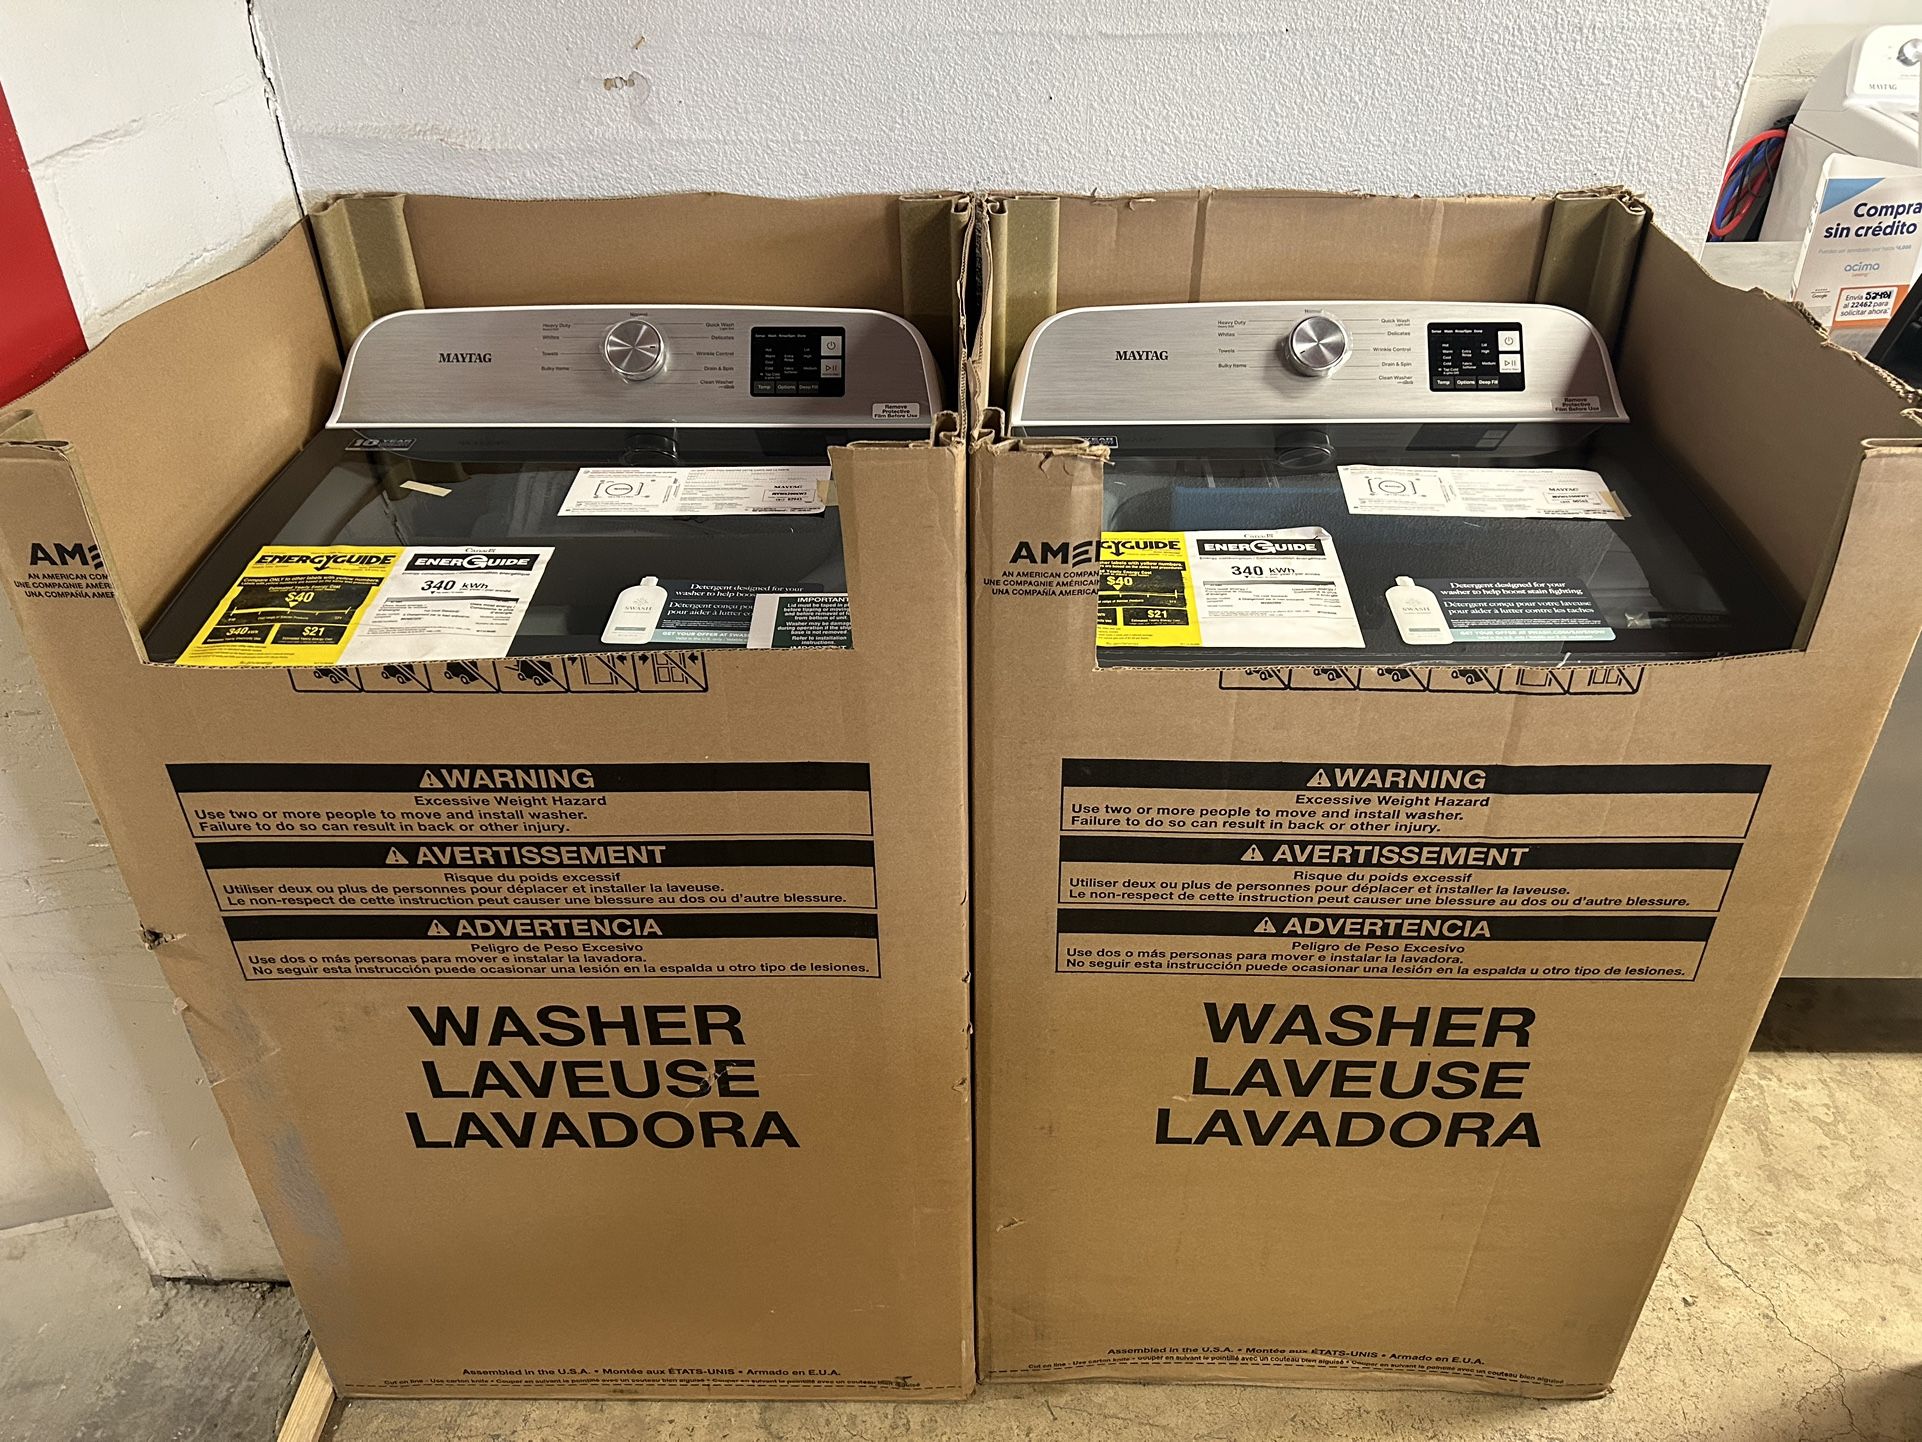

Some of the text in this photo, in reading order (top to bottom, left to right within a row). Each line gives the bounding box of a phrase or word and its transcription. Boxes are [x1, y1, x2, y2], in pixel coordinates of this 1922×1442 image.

[1853, 202, 1922, 219] Compra
[1824, 220, 1917, 238] sin crédito
[1844, 262, 1880, 272] acima
[1840, 309, 1867, 317] solicitar
[438, 352, 492, 363] MAYTAG
[1115, 350, 1169, 361] MAYTAG
[1204, 540, 1318, 554] ENERGUIDE
[255, 555, 396, 570] ENERGYGUIDE
[414, 554, 531, 569] ENERGUIDE
[1016, 571, 1061, 579] AMERICAN
[1231, 566, 1264, 576] 340
[14, 580, 31, 588] UNE
[32, 581, 84, 589] COMPAGNIE
[421, 580, 489, 591] 340 kWh
[983, 578, 1001, 586] UNE
[1003, 579, 1054, 587] COMPAGNIE
[1106, 576, 1133, 586] $40
[25, 590, 44, 598] UNA
[45, 590, 91, 599] COMPAÑÍA
[285, 591, 315, 604] $40
[1012, 587, 1056, 597] COMPAÑÍA
[1482, 588, 1502, 596] help
[1147, 609, 1168, 618] $21
[226, 627, 248, 636] 340
[302, 626, 325, 636] $21
[440, 768, 595, 788] WARNING
[1334, 768, 1486, 789] WARNING
[413, 795, 607, 808] Excessive Weight Hazard
[193, 808, 588, 821] Use two or more people to move and install washer.
[198, 821, 570, 834] Failure to do so can result in back or other injury.
[416, 845, 666, 865] AVERTISSEMENT
[1272, 844, 1530, 866] AVERTISSEMENT
[443, 872, 620, 884] Risque du poids excessif
[1069, 877, 1570, 895] Utiliser deux ou plus de personnes pour déplacer et installer la laveuse.
[456, 918, 663, 936] ADVERTENCIA
[1282, 917, 1491, 938] ADVERTENCIA
[1066, 947, 1464, 964] Use dos o más personas para mover e instalar la lavadora.
[406, 1004, 746, 1047] WASHER
[1203, 1001, 1536, 1048] WASHER
[421, 1058, 760, 1099] LAVEUSE
[1191, 1056, 1531, 1100] LAVEUSE
[404, 1110, 801, 1149] LAVADORA
[1155, 1107, 1541, 1148] LAVADORA
[462, 1368, 522, 1376] Assembled
[667, 1367, 735, 1375] ÉTATS-UNIS
[746, 1368, 789, 1376] Armado
